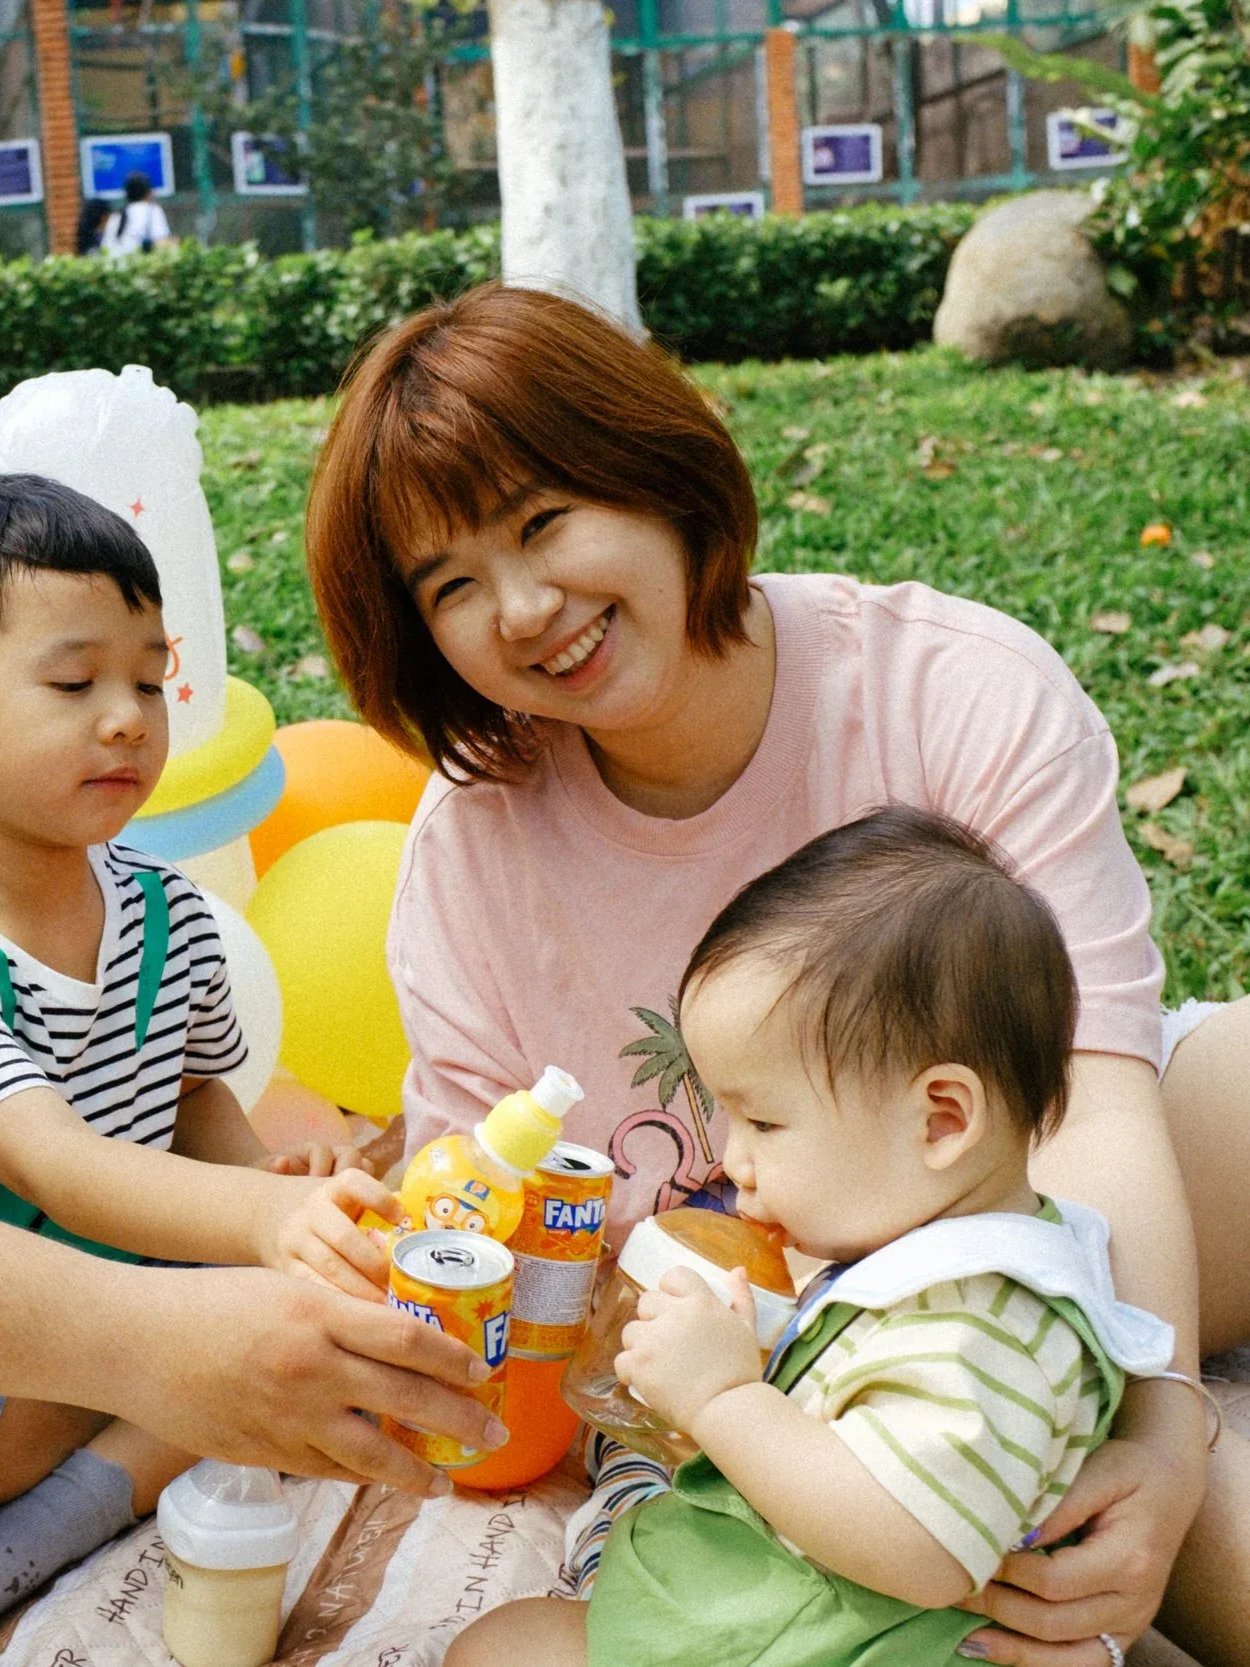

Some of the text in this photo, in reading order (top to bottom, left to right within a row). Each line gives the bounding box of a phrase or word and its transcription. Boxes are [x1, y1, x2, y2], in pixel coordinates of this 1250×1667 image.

[97, 1568, 149, 1625] HAND
[456, 1513, 514, 1613] IN HAND
